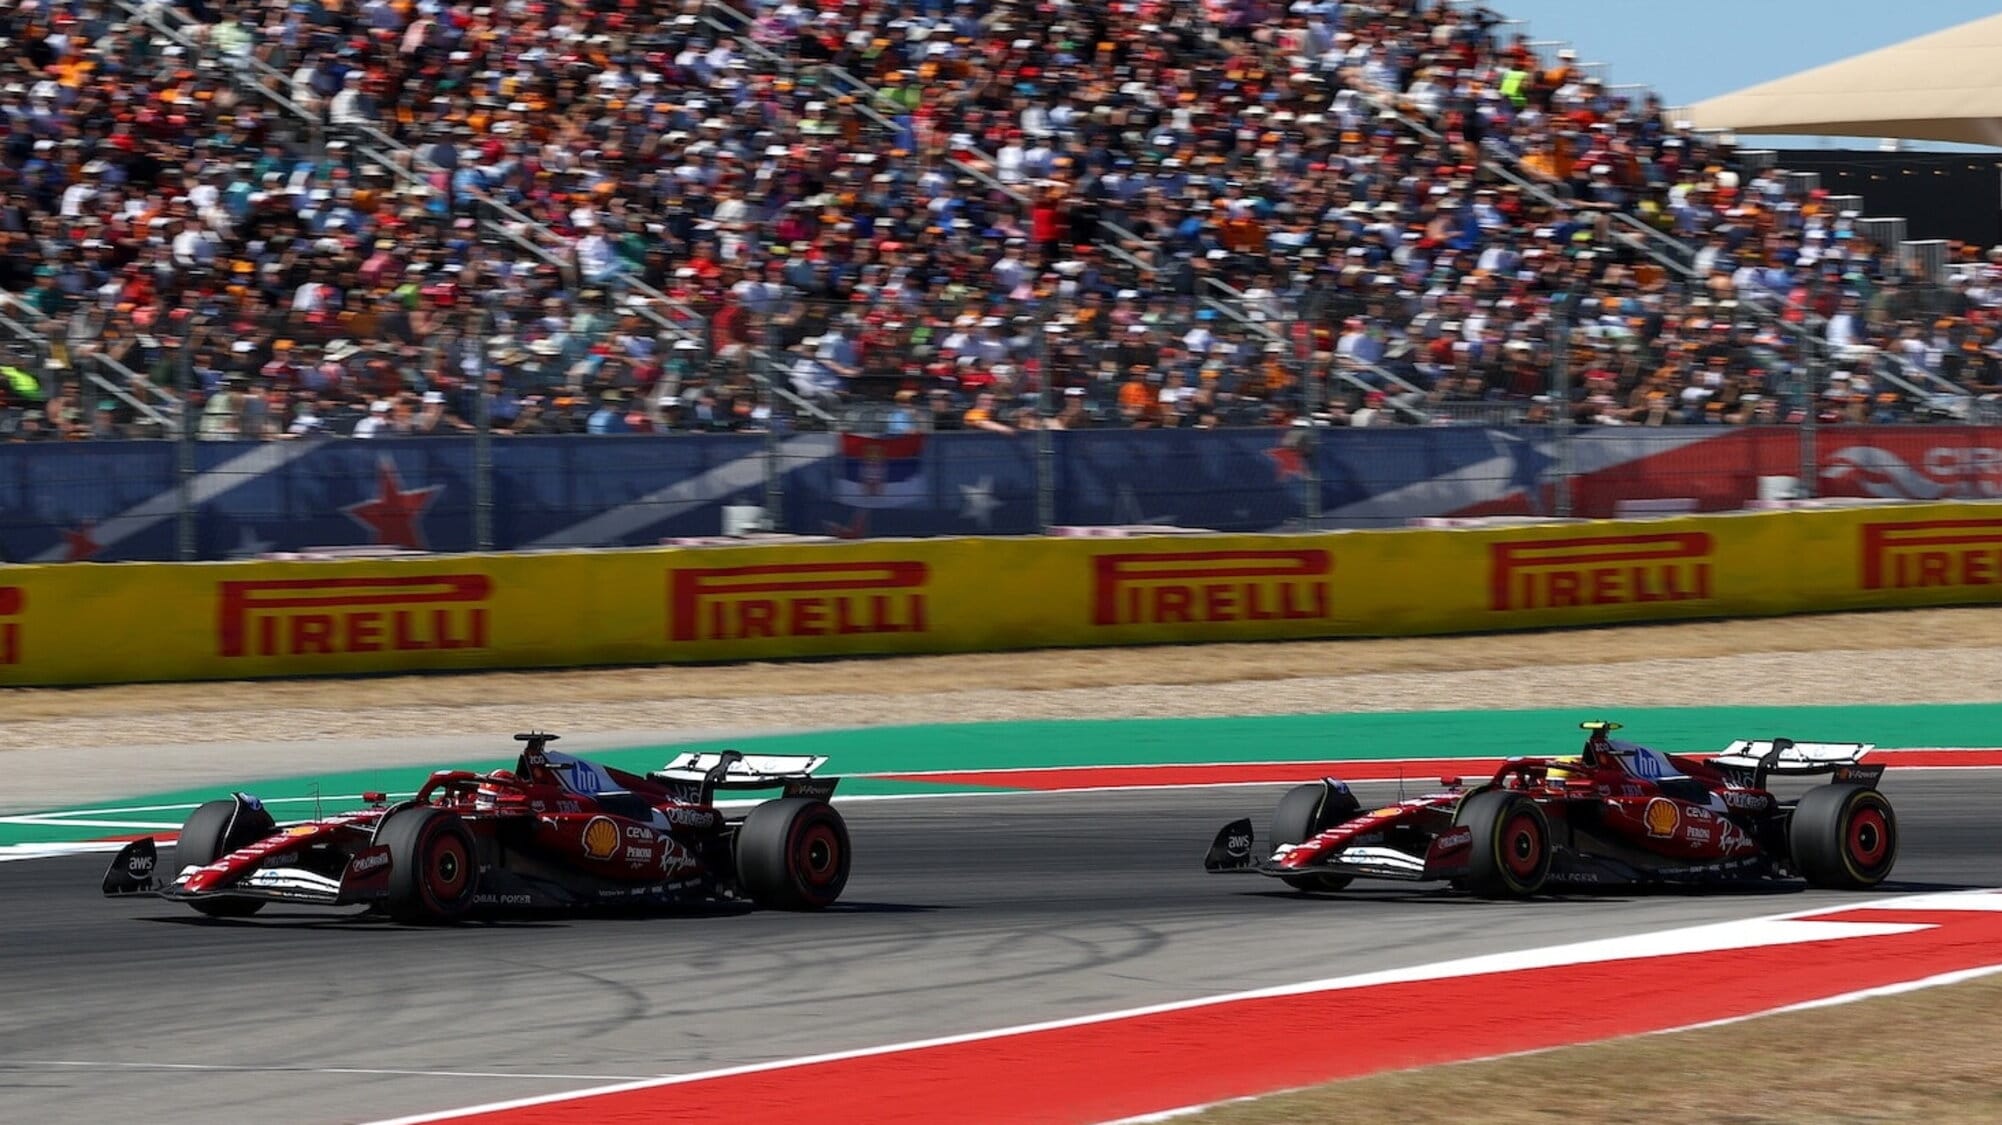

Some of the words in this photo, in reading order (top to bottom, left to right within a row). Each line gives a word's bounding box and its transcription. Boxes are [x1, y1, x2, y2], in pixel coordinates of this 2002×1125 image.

[1091, 549, 1332, 627] PIRELLI
[1489, 532, 1714, 611] PIRELLI
[1860, 518, 2002, 590] PIRE
[218, 574, 493, 657] PIRELLI
[668, 561, 929, 642] PIRELLI
[574, 760, 600, 795] hp
[128, 856, 153, 871] aws
[1228, 834, 1250, 849] aws
